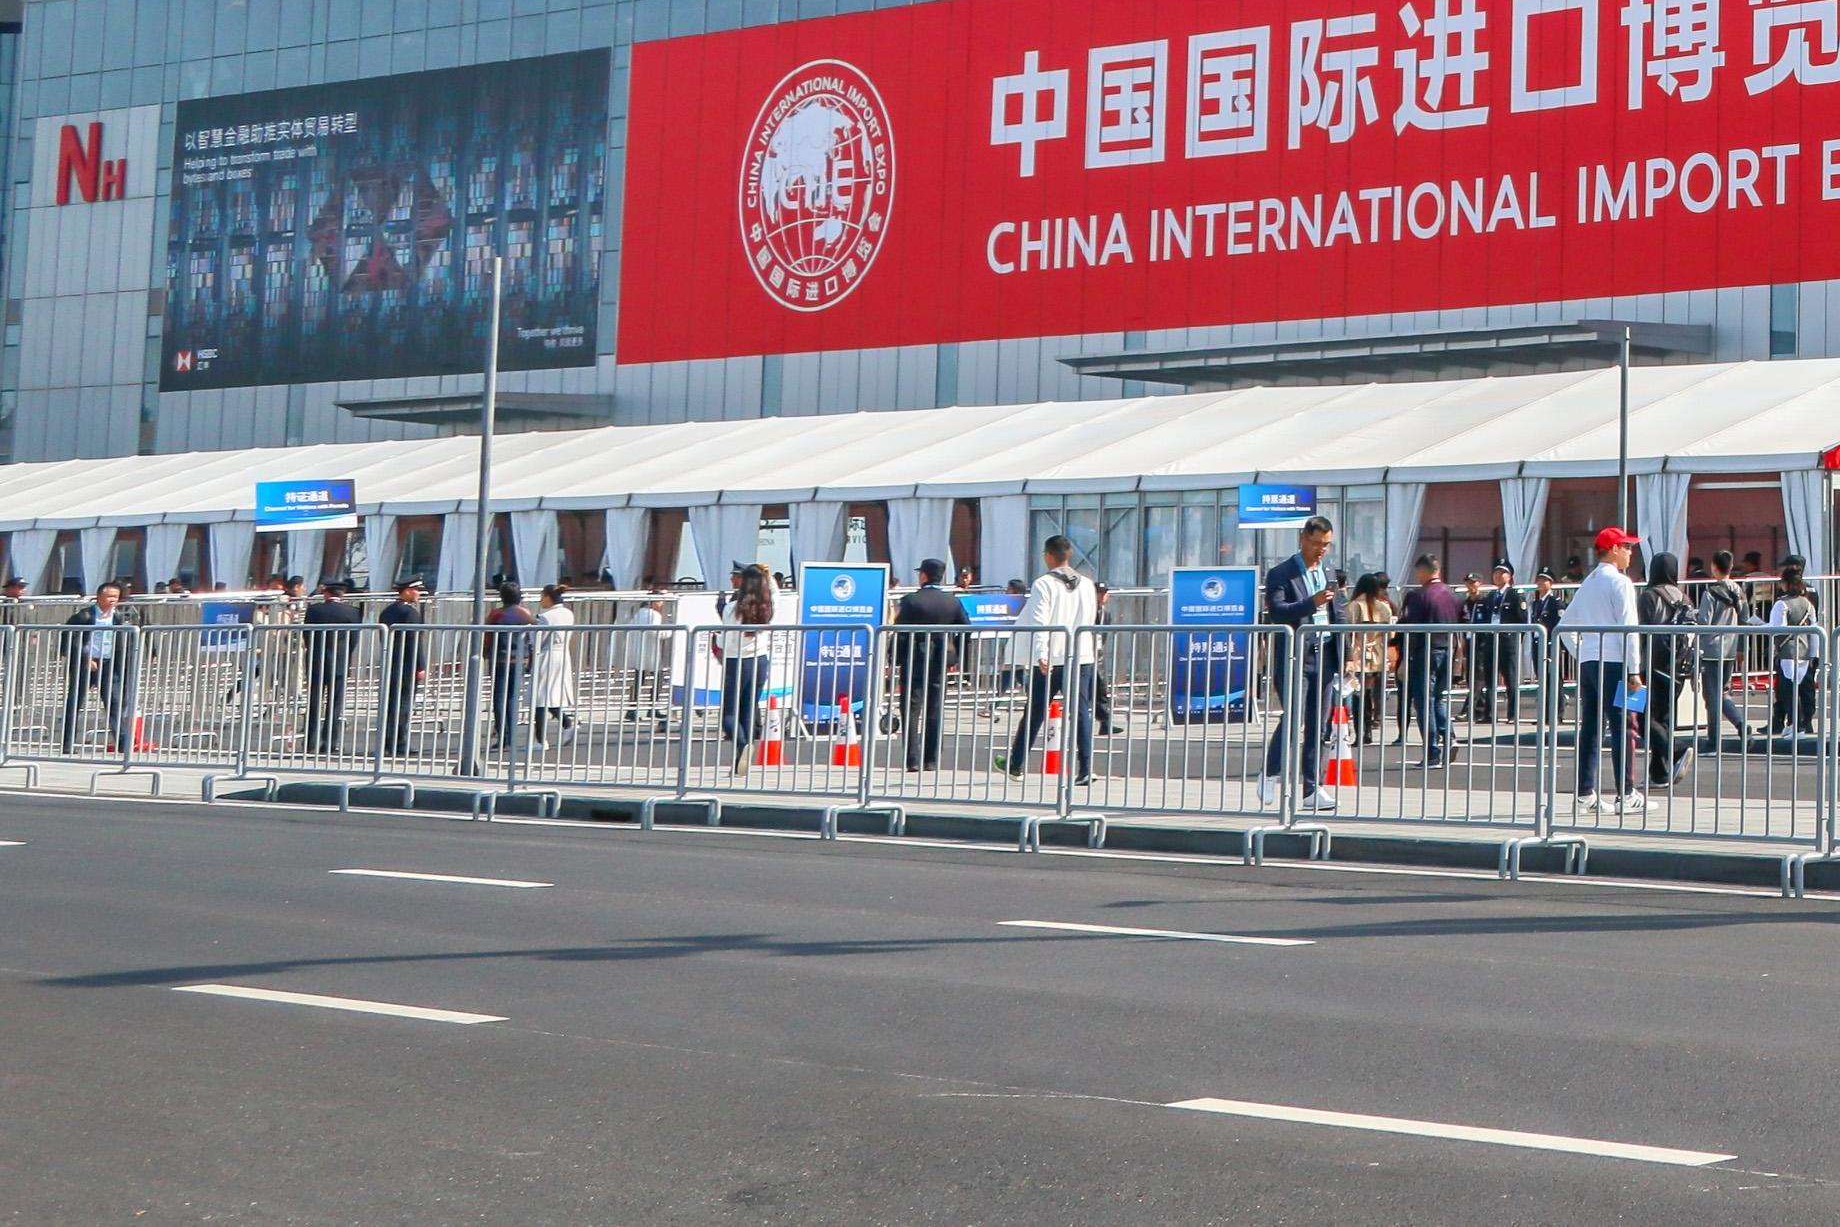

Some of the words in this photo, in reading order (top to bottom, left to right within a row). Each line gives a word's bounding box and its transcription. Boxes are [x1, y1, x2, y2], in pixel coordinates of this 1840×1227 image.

[184, 111, 358, 151] 以智慧金融助推实体贸易转型
[184, 156, 218, 170] Helping
[219, 156, 229, 166] to
[230, 150, 271, 165] transform
[273, 146, 296, 160] trade
[298, 143, 318, 157] with
[747, 149, 764, 209] CHINA
[758, 76, 845, 145] INTERNATIONAL
[847, 84, 883, 140] IMPORT
[874, 143, 887, 196] EXPO
[986, 212, 1134, 275] CHINA
[1149, 171, 1557, 262] INTERNATIONAL
[1577, 142, 1800, 224] IMPORT
